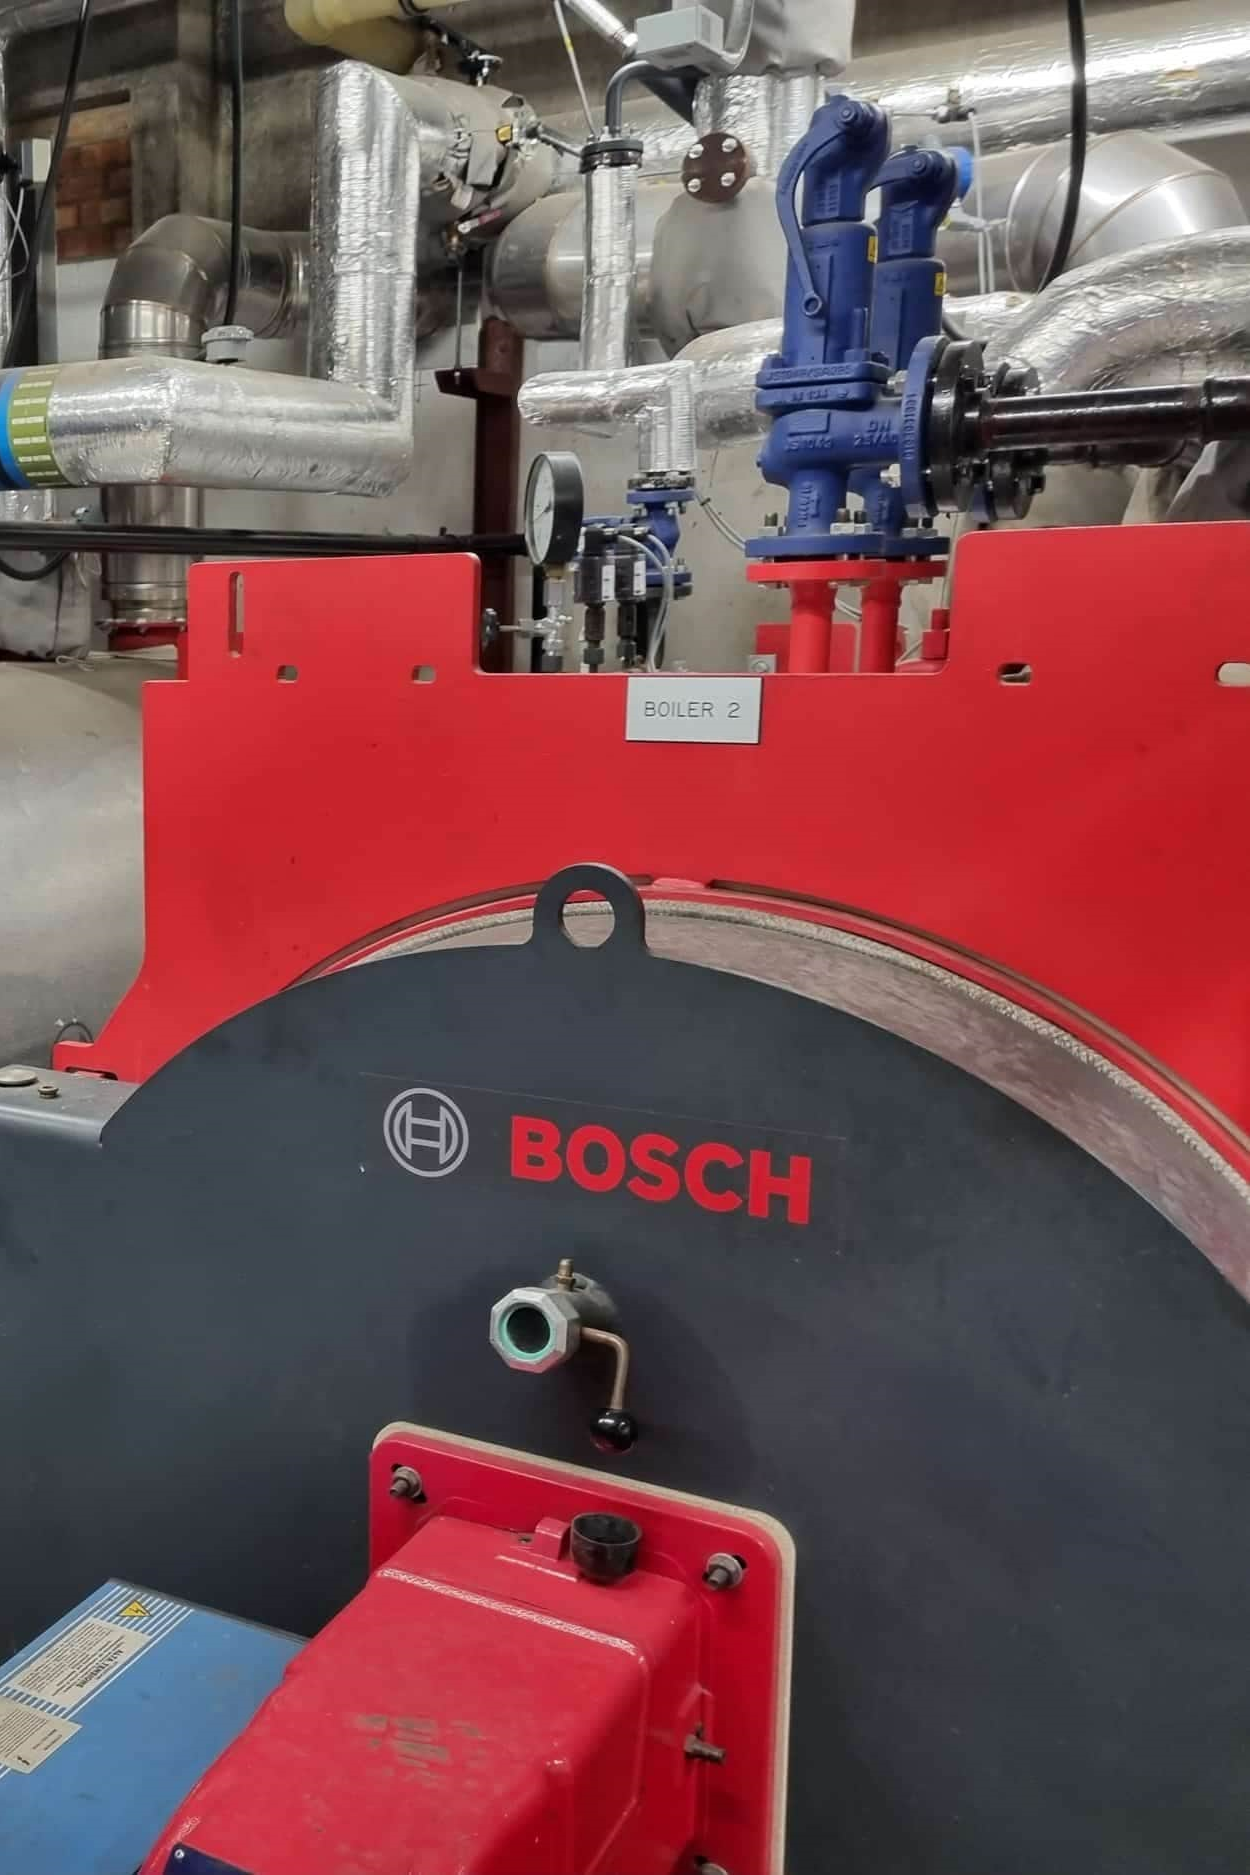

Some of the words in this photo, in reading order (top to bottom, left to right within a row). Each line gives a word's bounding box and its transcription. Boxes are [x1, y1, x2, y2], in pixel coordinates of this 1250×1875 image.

[644, 701, 714, 718] BOILER
[727, 702, 741, 718] 2
[510, 1114, 812, 1225] BOSCH
